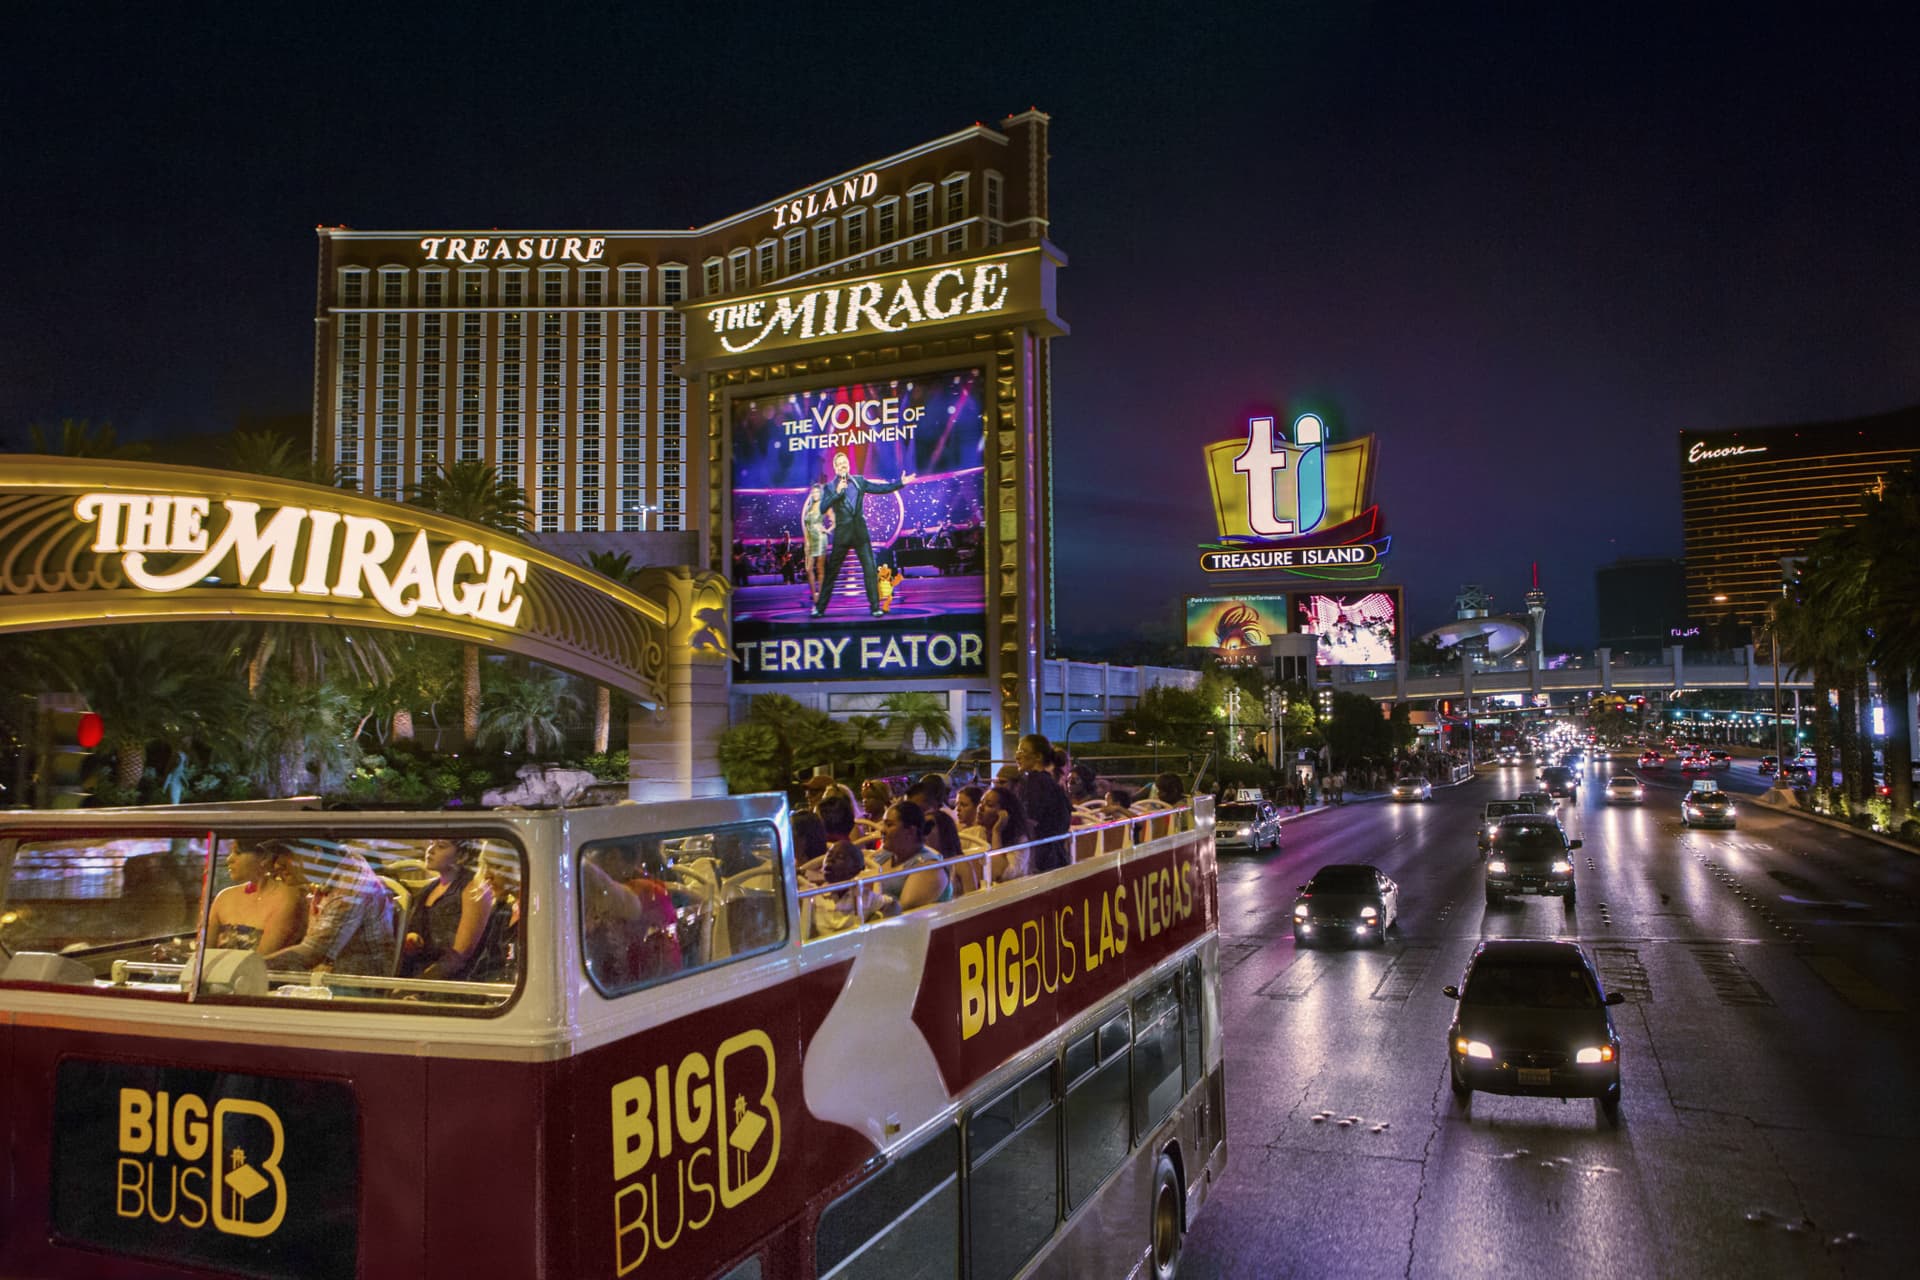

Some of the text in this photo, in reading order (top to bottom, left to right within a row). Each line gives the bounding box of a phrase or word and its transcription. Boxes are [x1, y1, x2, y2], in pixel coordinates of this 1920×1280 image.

[420, 172, 878, 263] TREASURE ISLAND
[707, 263, 1007, 352] THE MIRAGE
[782, 398, 926, 436] THE VOICE OF
[789, 424, 918, 452] ENTERTAINMENT
[1688, 441, 1767, 463] Encore
[73, 492, 528, 628] THE MIRAGE
[1212, 548, 1365, 569] TREASURE ISLAND
[736, 633, 983, 673] TERRY FATOR
[1084, 884, 1129, 972] LAS
[1134, 861, 1192, 942] VEGAS
[119, 1087, 209, 1161] BIG
[611, 1052, 713, 1181] BIG
[117, 1158, 208, 1228] BUS
[614, 1146, 715, 1278] BUS
